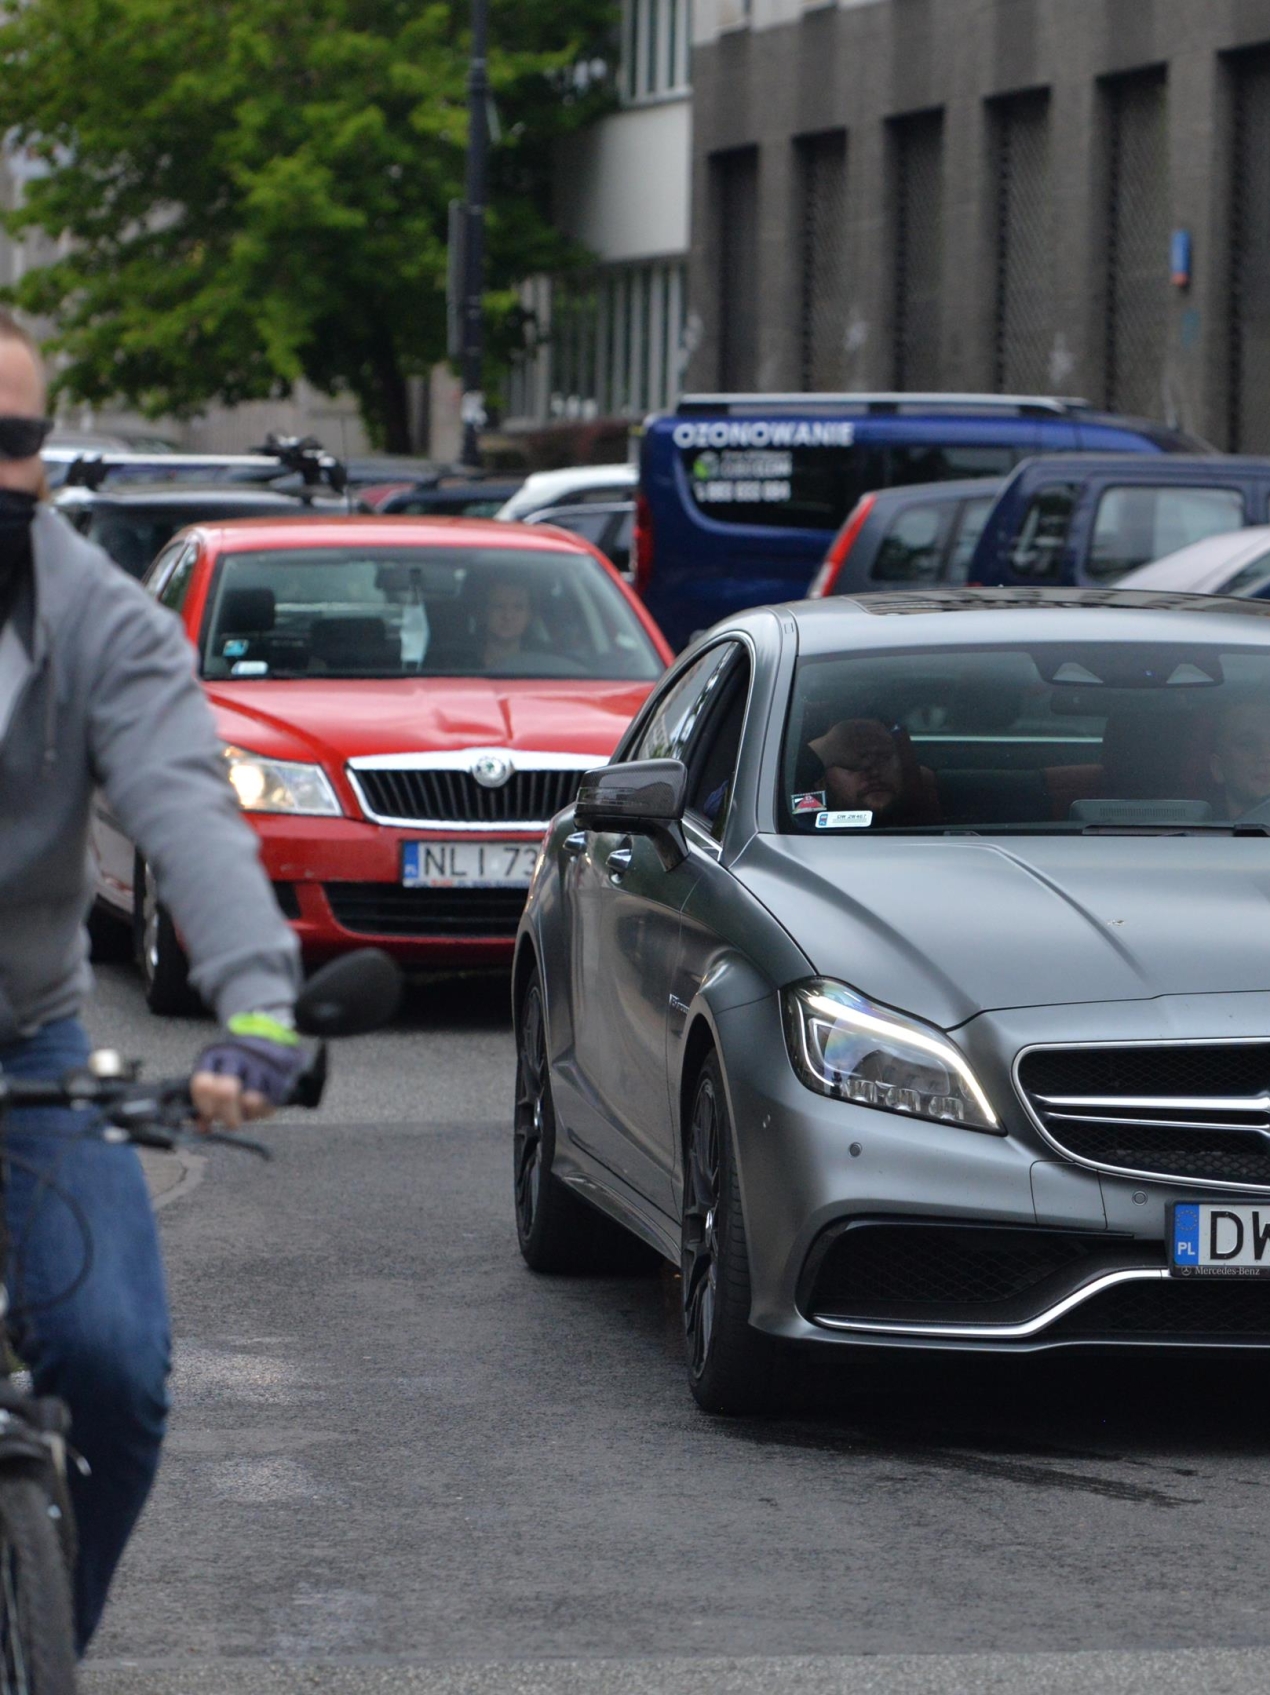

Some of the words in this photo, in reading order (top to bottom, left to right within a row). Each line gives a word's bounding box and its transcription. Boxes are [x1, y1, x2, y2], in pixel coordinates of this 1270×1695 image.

[672, 421, 854, 449] OZONOWANIE
[1177, 1242, 1196, 1256] PL
[1195, 1266, 1260, 1276] Mercedes-Benz
